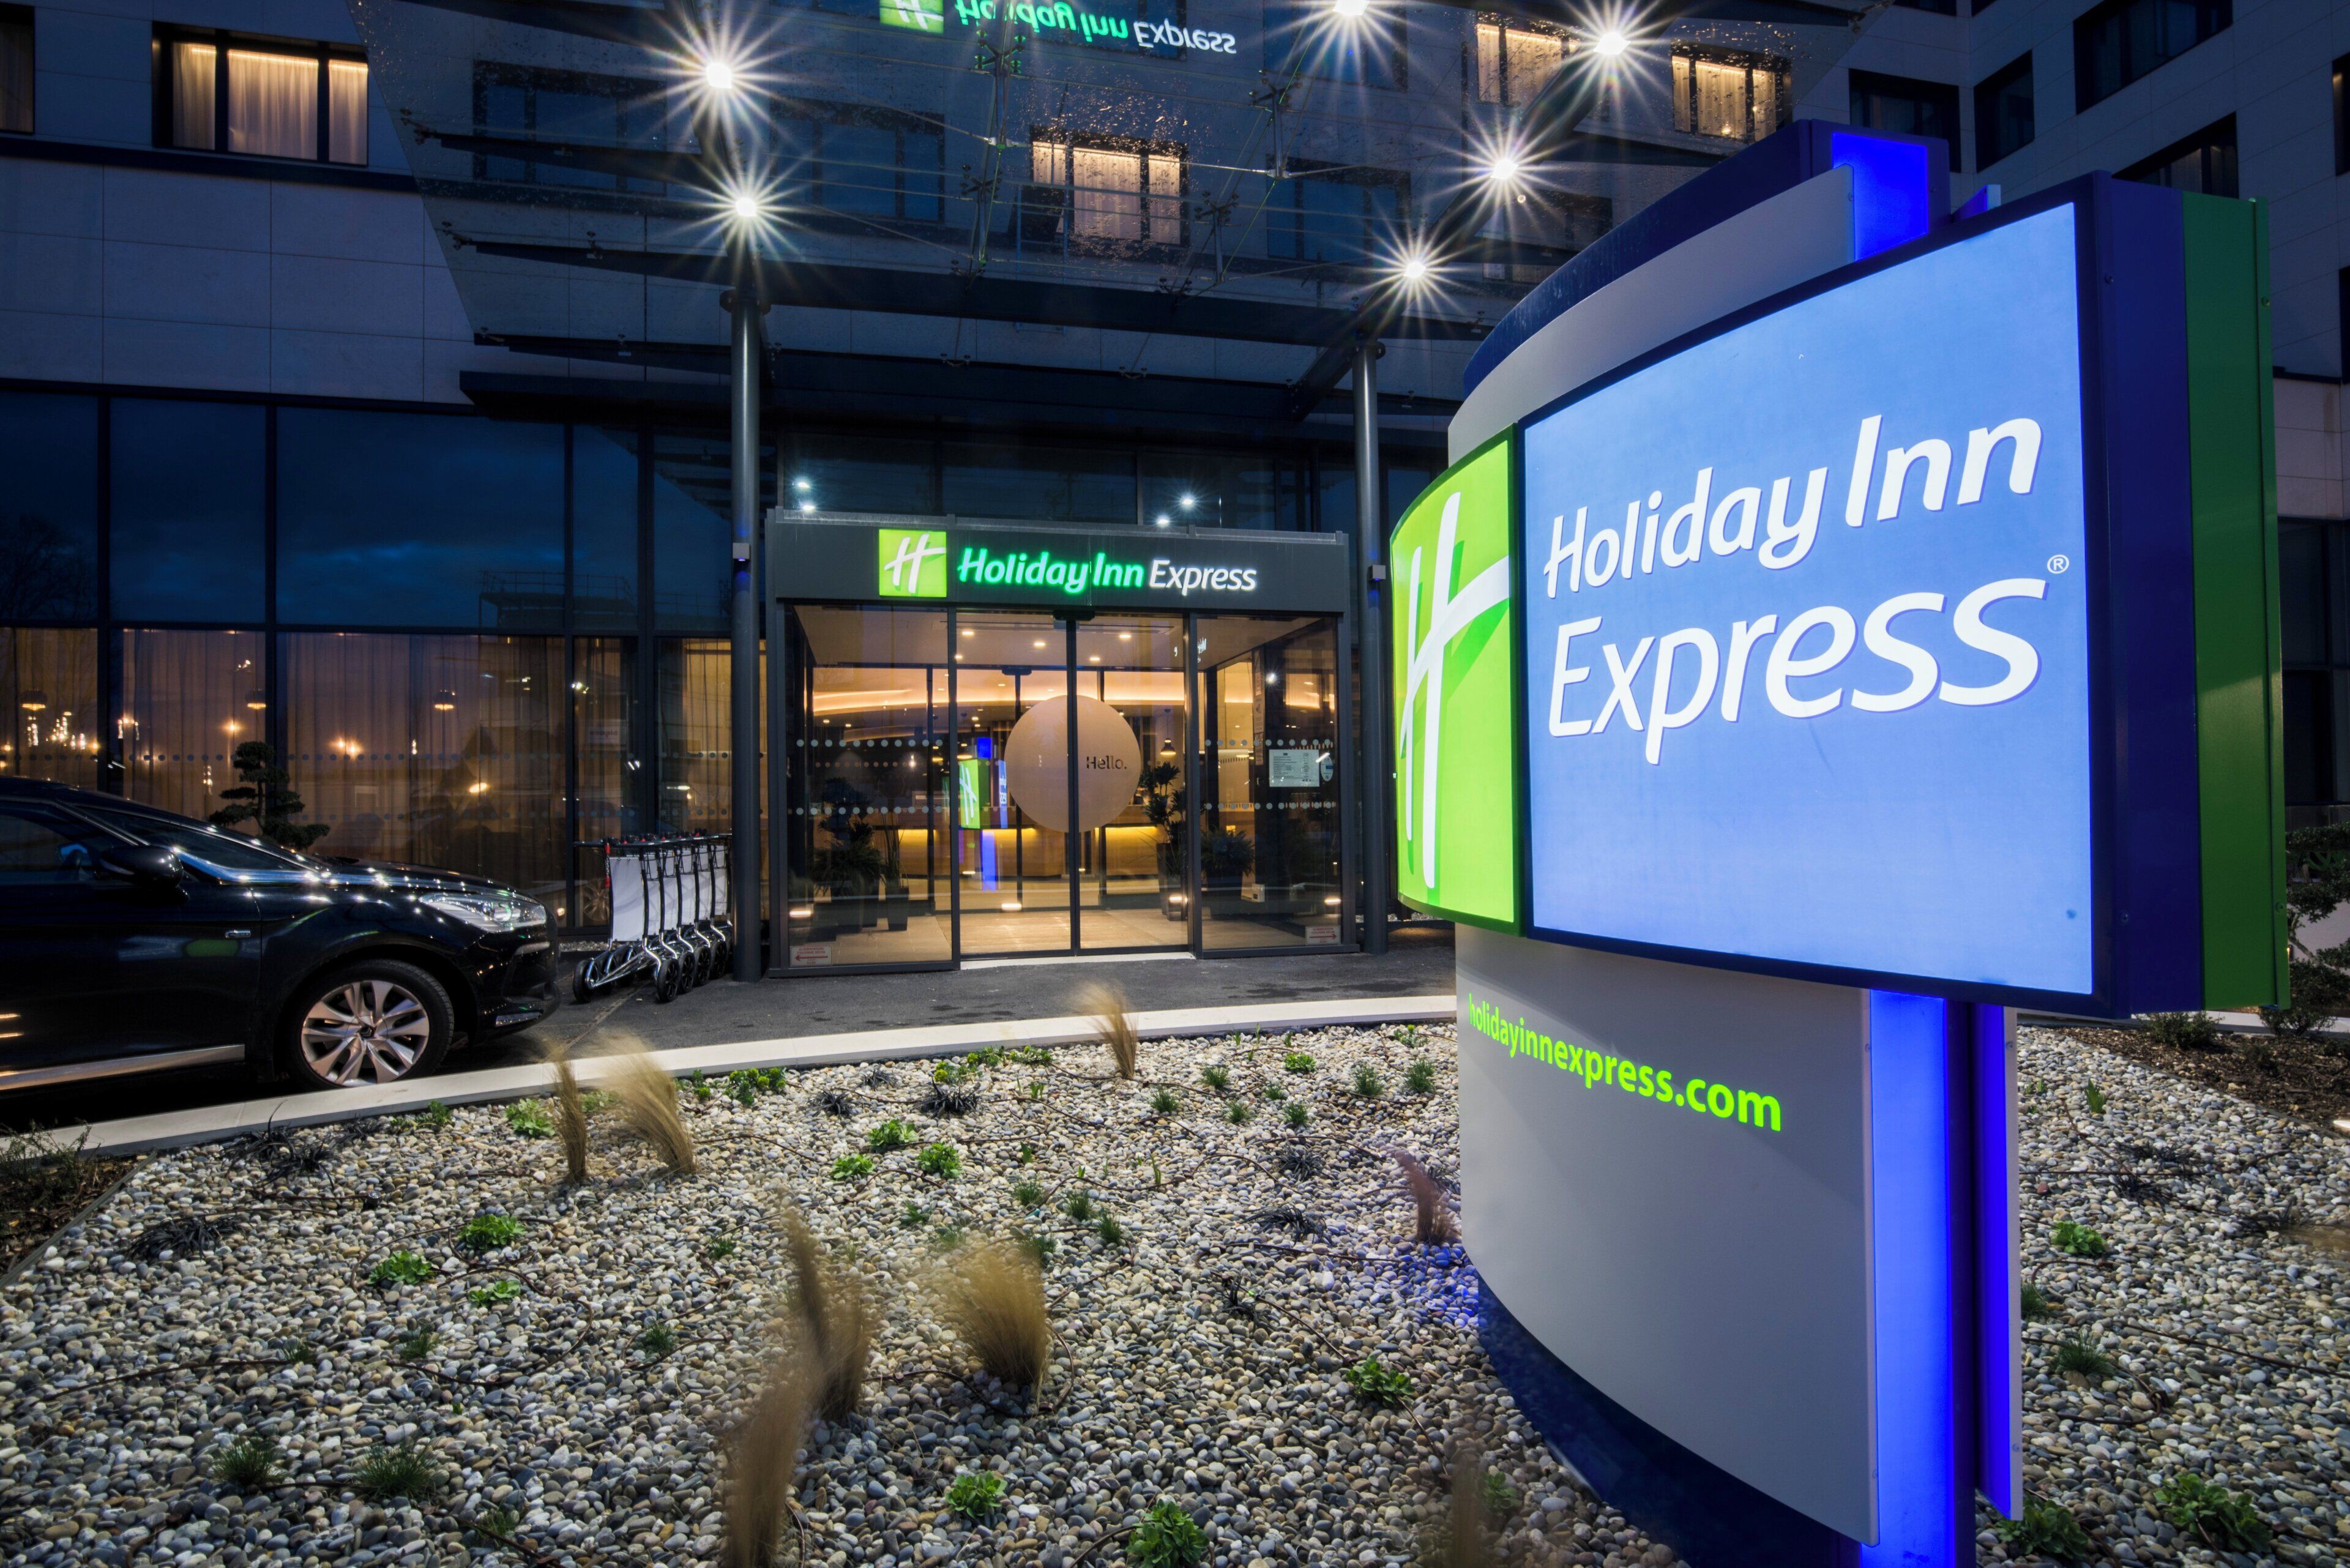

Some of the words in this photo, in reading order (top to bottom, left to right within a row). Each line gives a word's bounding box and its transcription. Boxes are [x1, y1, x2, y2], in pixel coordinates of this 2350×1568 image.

[957, 547, 1090, 594] Holiday
[1092, 551, 1144, 588] Inn
[1149, 559, 1258, 597] Express
[1543, 466, 1828, 599] Holiday
[1845, 414, 2044, 528] Inn
[1548, 577, 2048, 765] Express
[1086, 755, 1127, 769] Hello.
[1469, 992, 1781, 1132] holidayinnexpress.com
